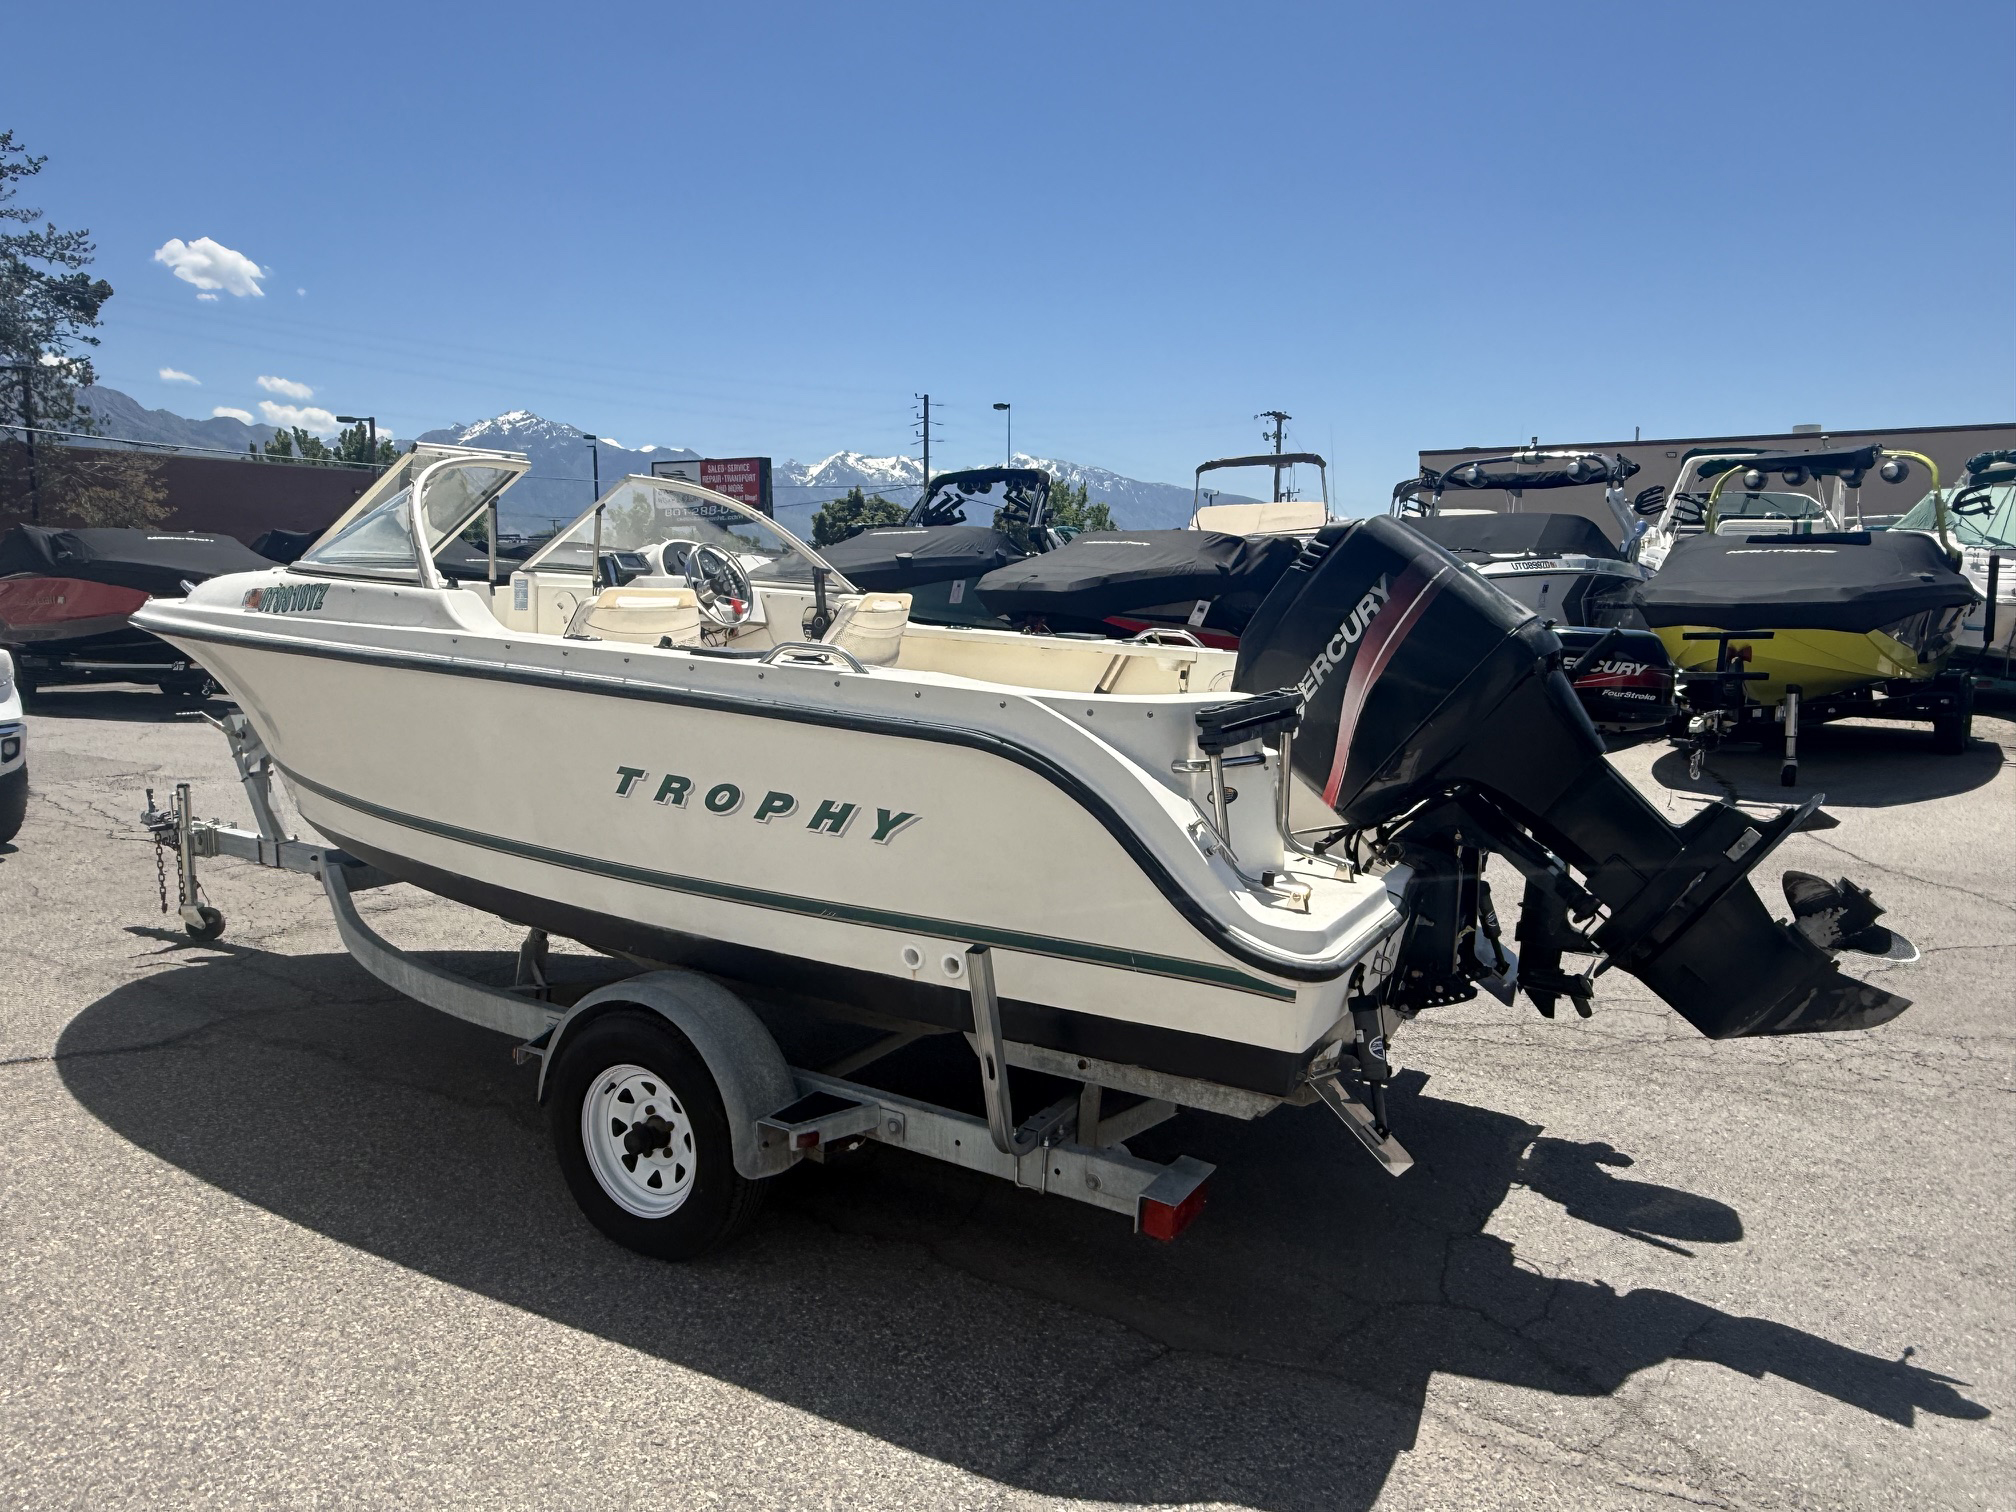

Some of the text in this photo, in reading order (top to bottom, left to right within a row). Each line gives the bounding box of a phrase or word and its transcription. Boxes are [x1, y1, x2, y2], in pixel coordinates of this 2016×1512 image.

[1293, 572, 1391, 739] ERCURY
[1601, 688, 1657, 701] FourStroke
[614, 765, 923, 846] TROPHY
